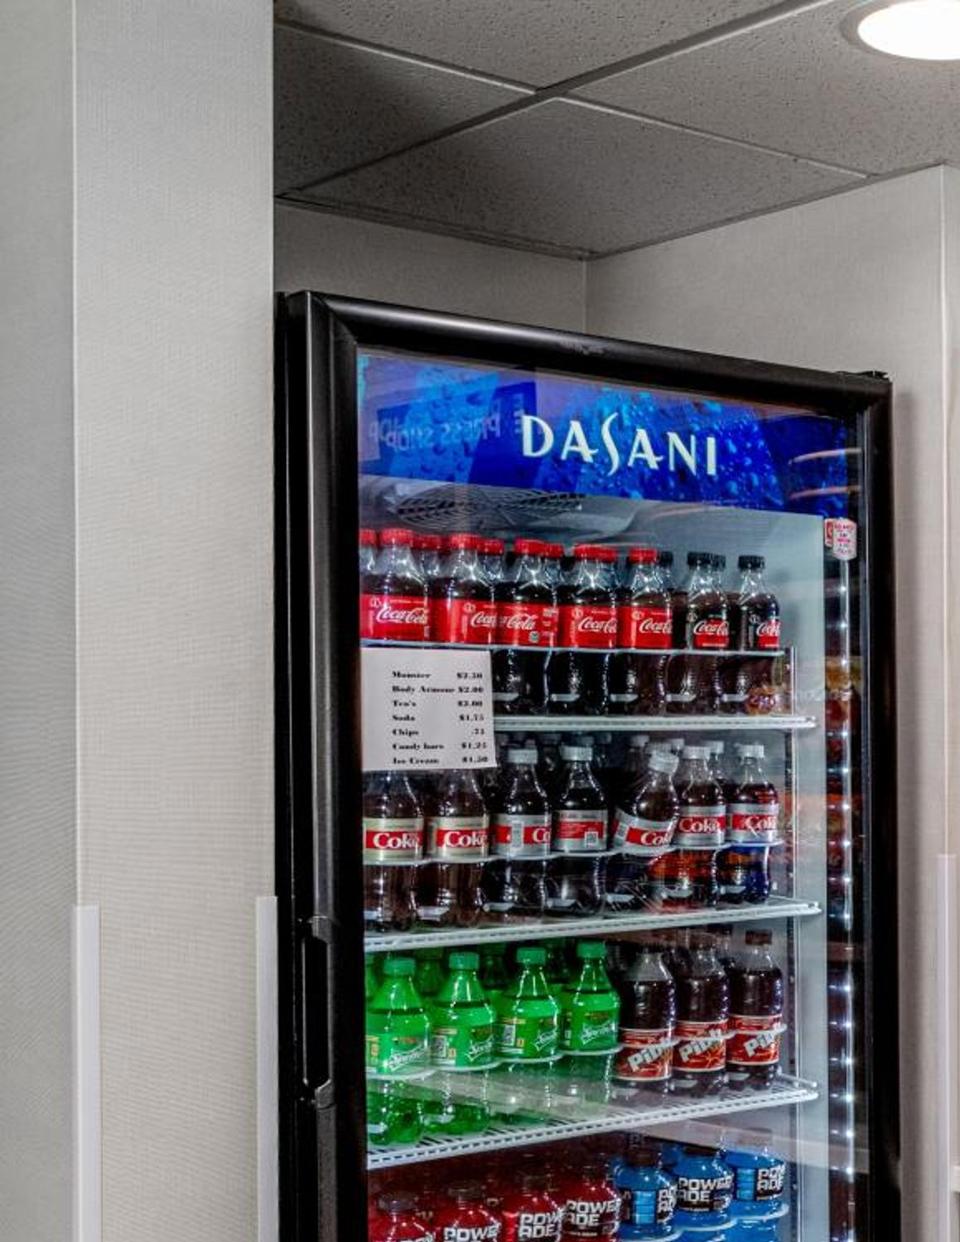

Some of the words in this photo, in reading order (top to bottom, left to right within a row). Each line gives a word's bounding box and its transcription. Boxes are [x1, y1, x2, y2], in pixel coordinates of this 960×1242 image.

[521, 412, 717, 476] DASANI
[391, 728, 420, 738] Chips
[679, 817, 721, 834] Coke
[373, 832, 420, 849] Coke
[443, 831, 488, 848] Coke
